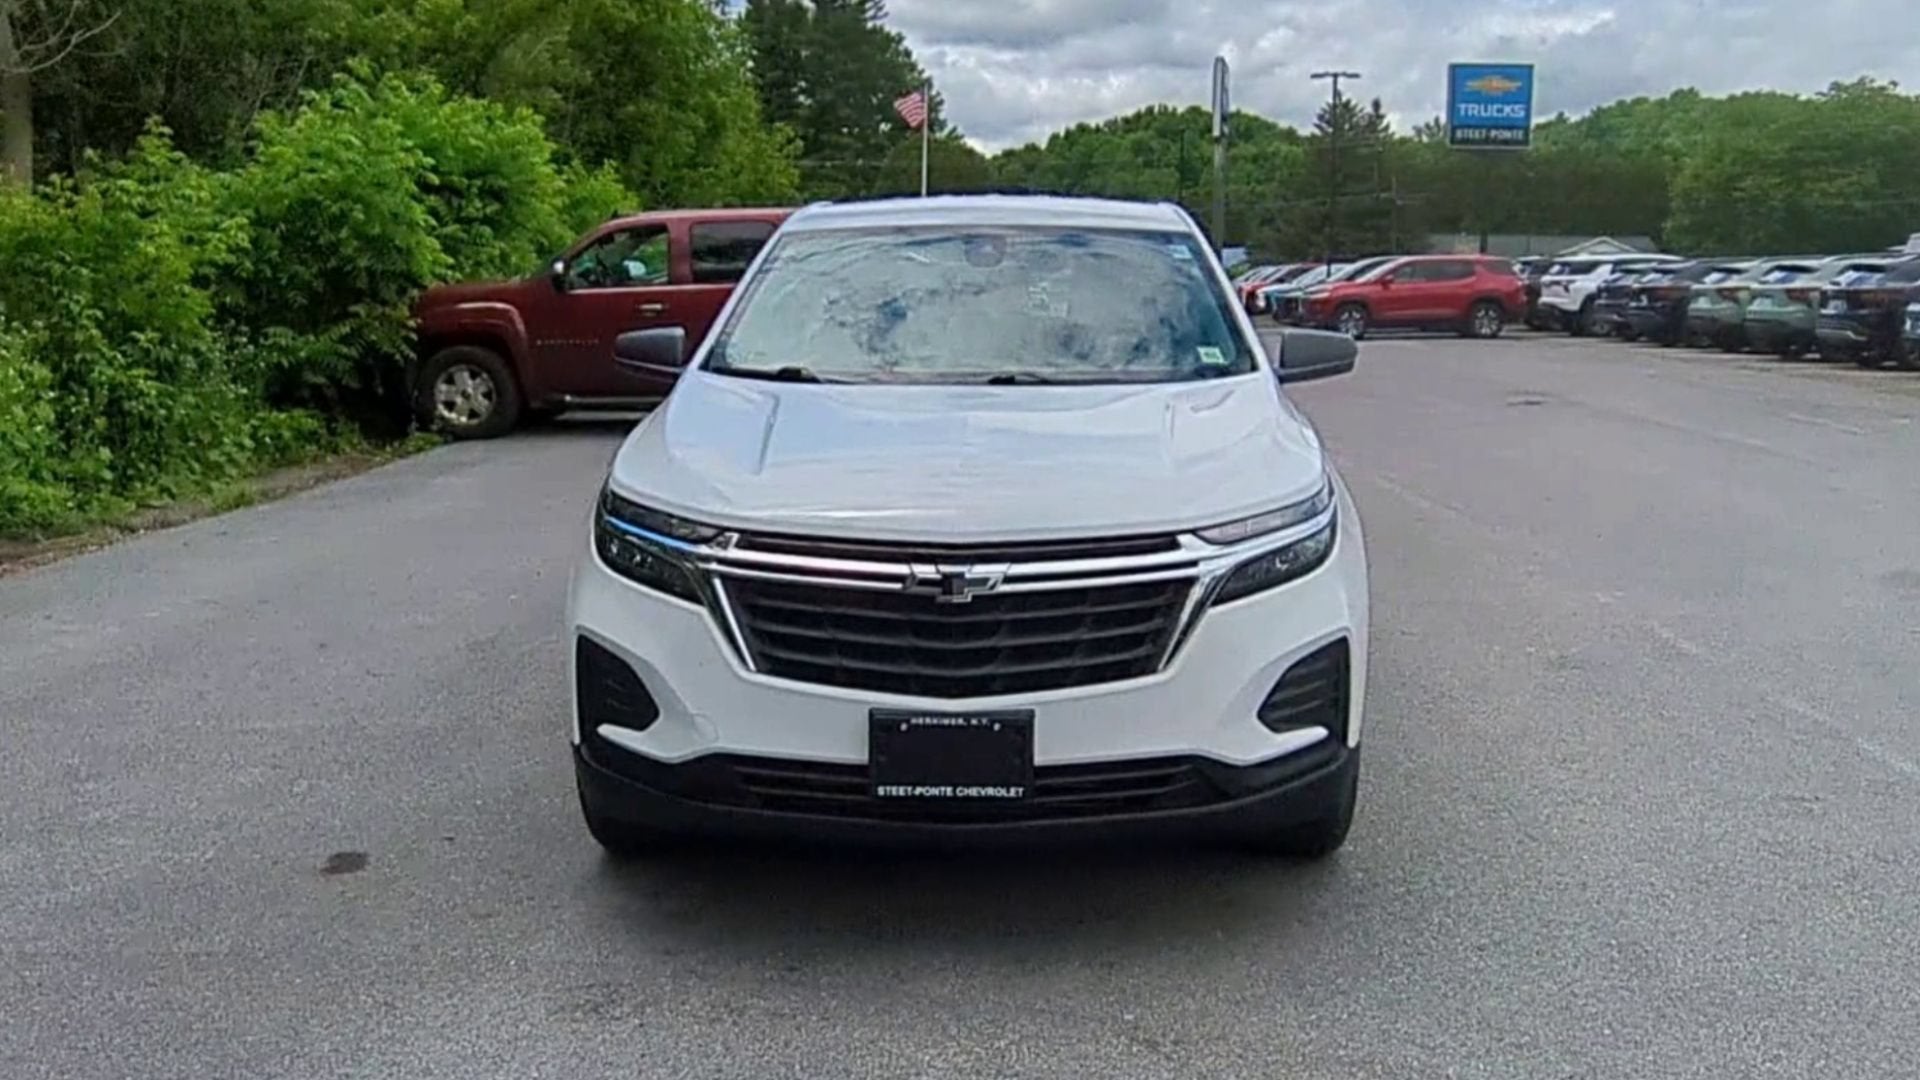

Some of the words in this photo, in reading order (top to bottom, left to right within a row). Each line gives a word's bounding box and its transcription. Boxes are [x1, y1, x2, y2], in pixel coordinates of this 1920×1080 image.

[1457, 103, 1527, 118] TRUCKS
[877, 785, 953, 797] STEET-PONTE
[956, 786, 1024, 797] CHEVROLET
